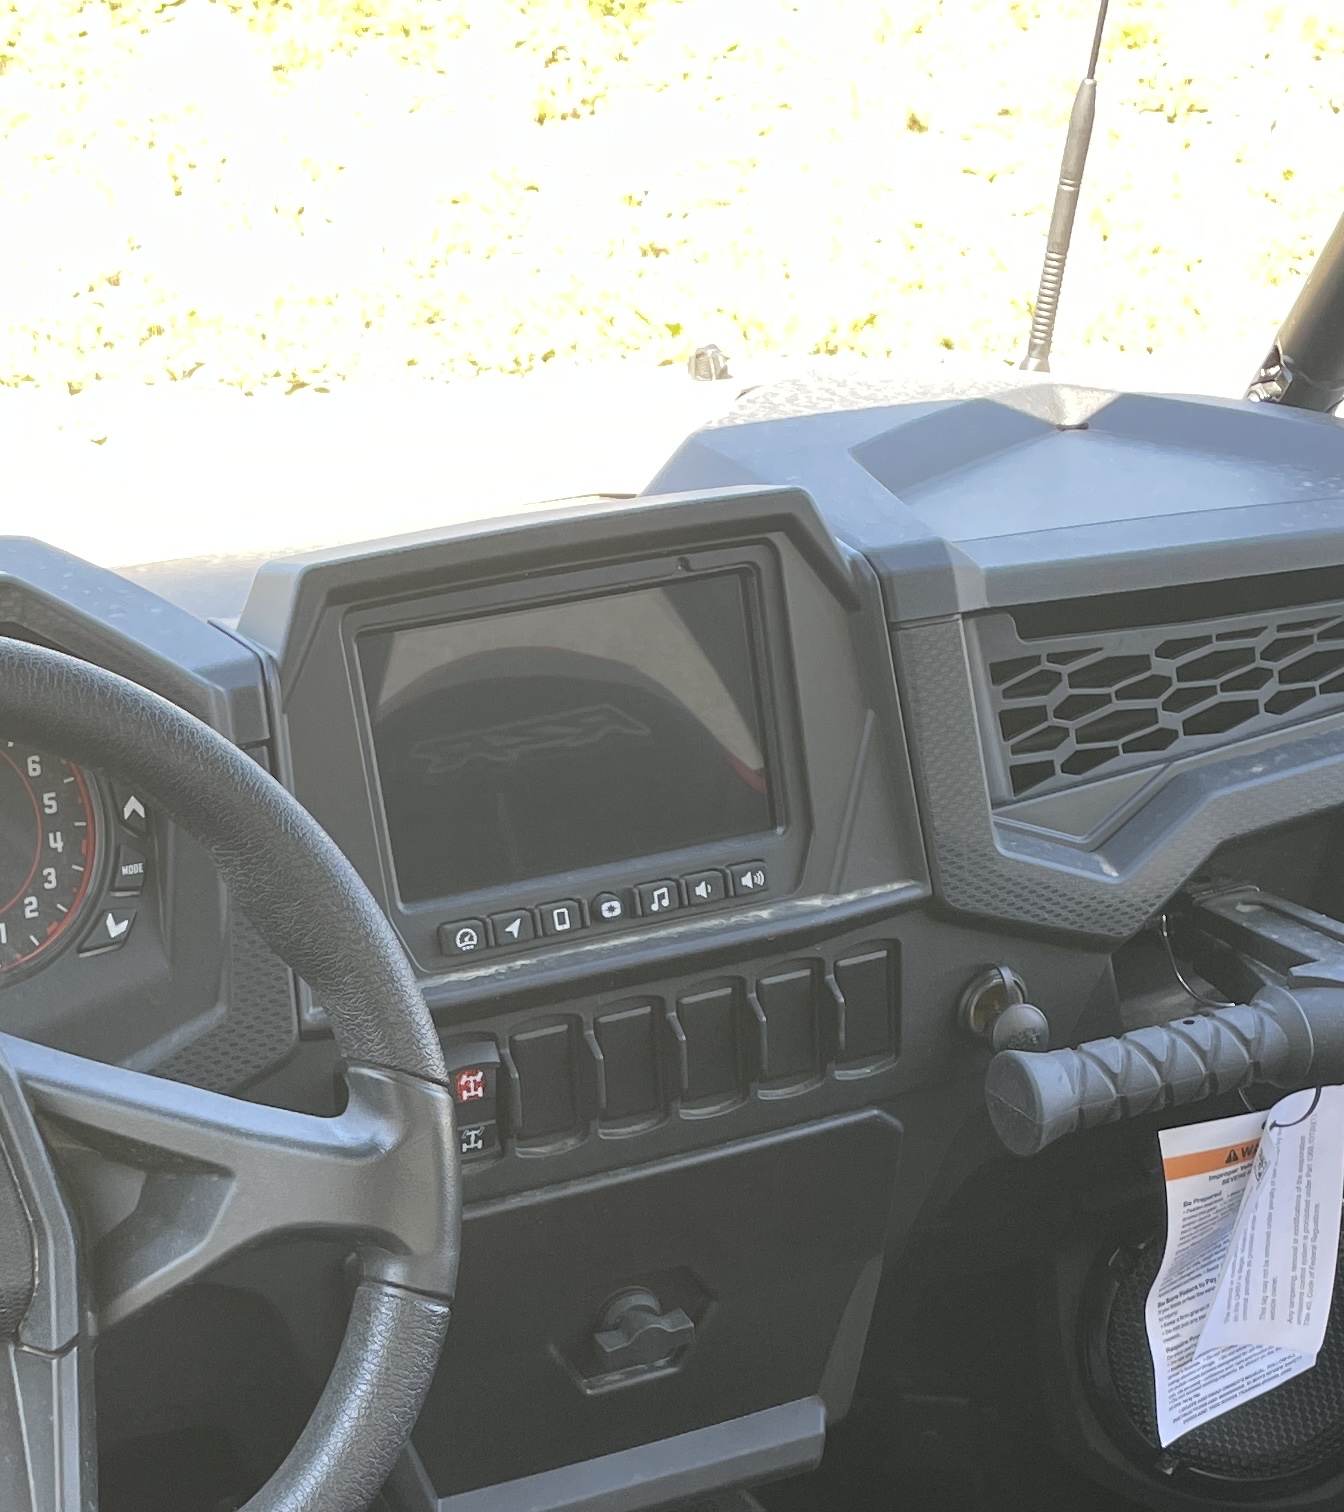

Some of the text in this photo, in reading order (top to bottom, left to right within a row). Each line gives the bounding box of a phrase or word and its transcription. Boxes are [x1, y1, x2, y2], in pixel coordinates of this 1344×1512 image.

[27, 755, 41, 777] 6
[43, 792, 57, 814] 5
[49, 832, 64, 852] 4
[43, 867, 57, 890] 3
[121, 862, 143, 875] MODE
[24, 896, 39, 919] 2
